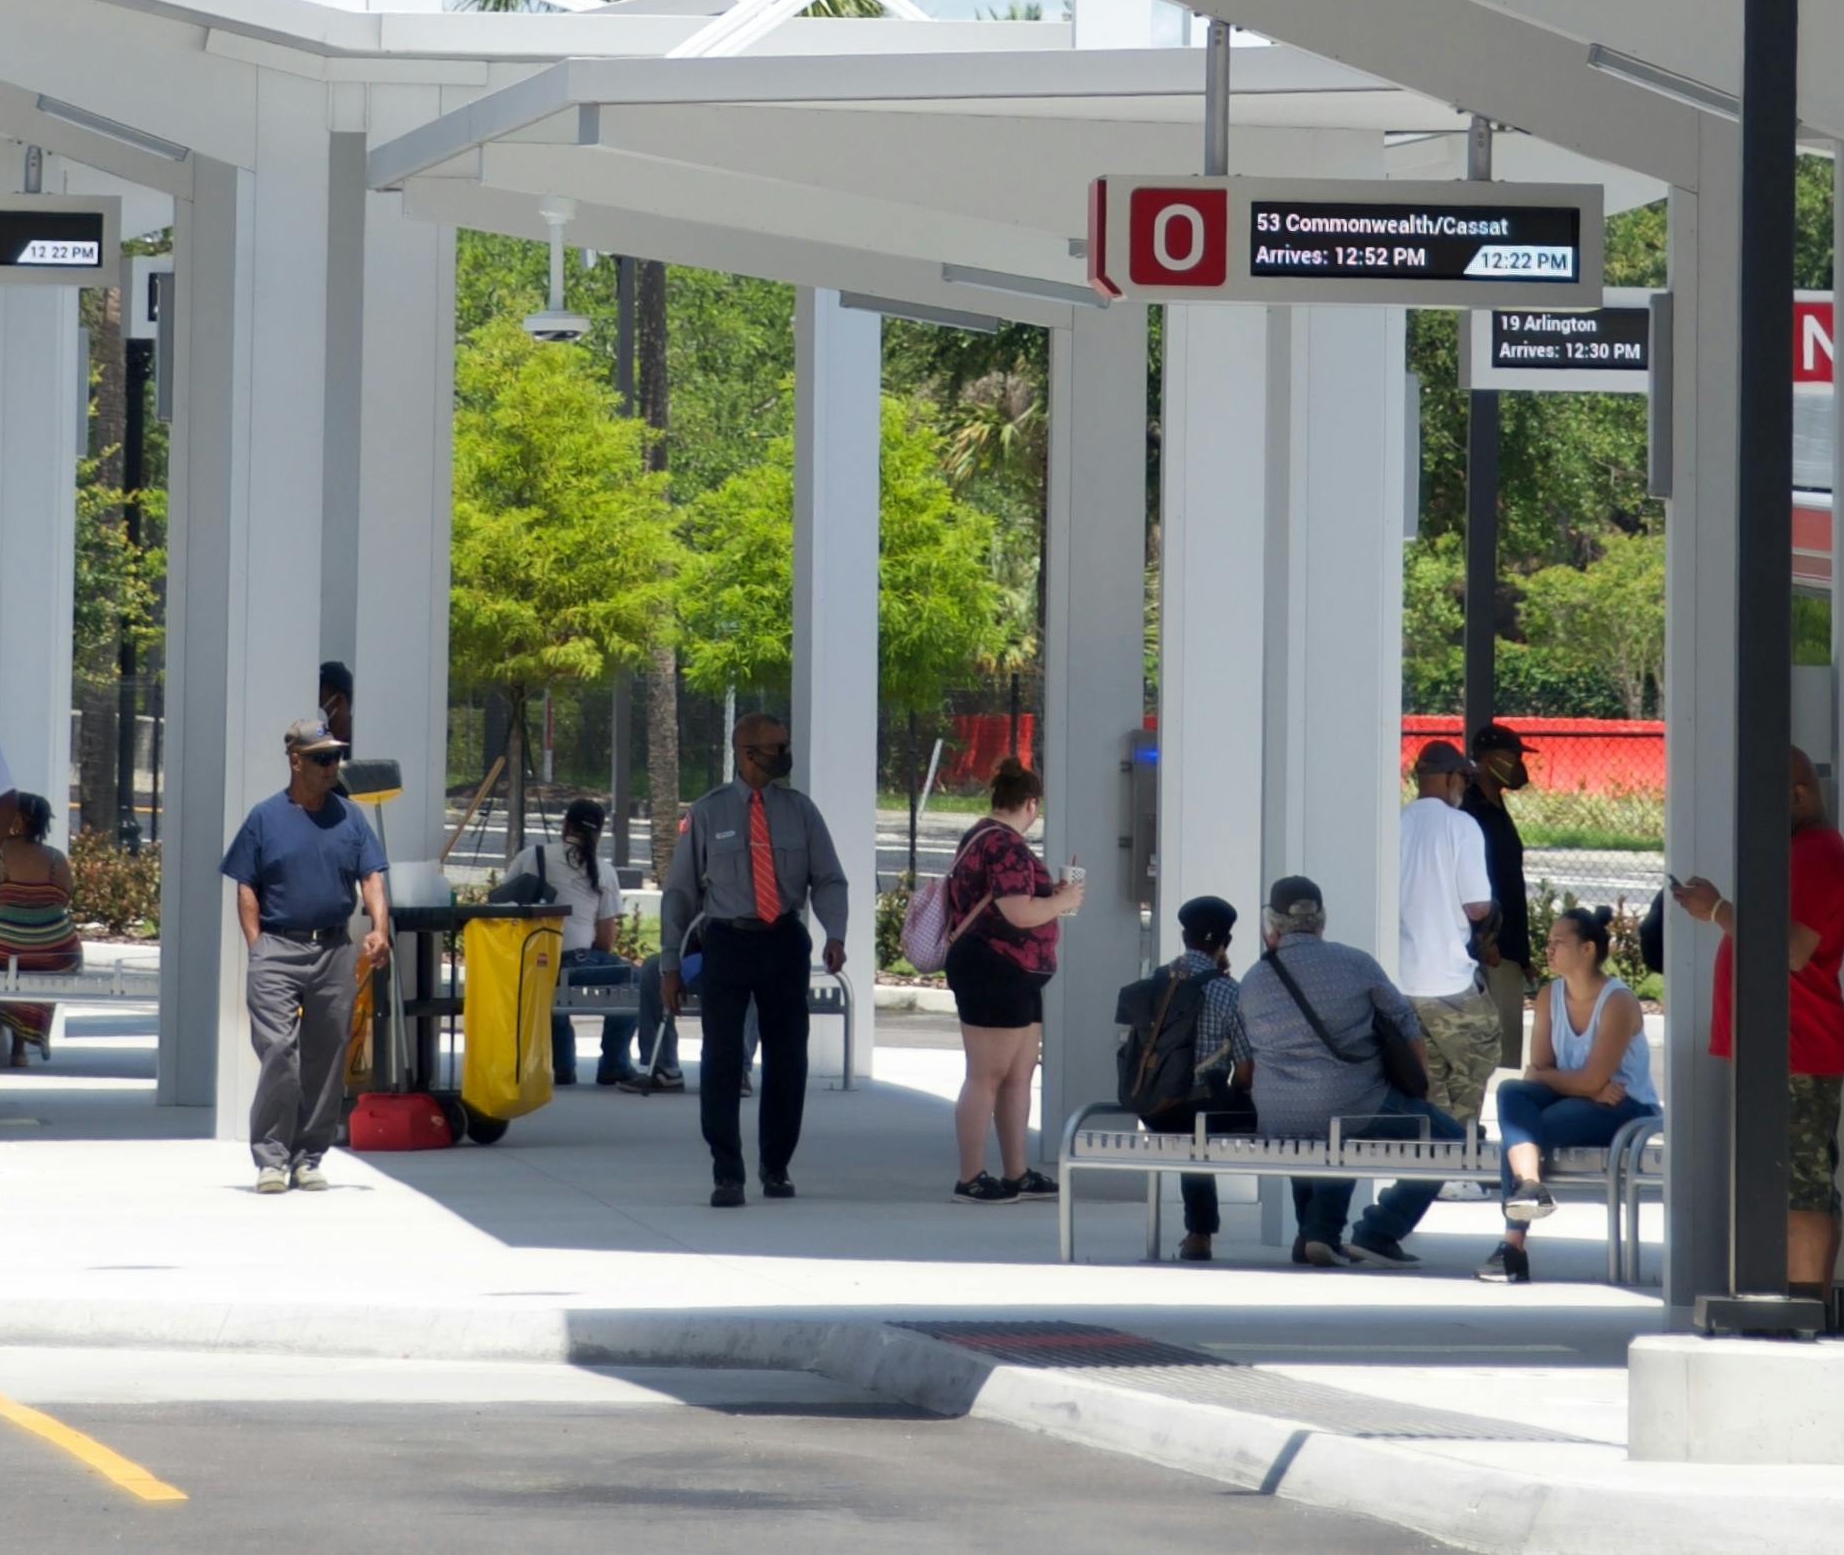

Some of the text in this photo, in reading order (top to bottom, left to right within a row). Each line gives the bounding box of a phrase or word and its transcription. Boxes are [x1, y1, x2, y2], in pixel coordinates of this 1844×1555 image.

[1256, 212, 1509, 236] 53 Commonwealth/Cassat
[1153, 203, 1204, 271] O
[72, 246, 94, 259] PM
[1255, 243, 1426, 267] Arrives: 12:52 PM
[1481, 252, 1568, 270] 12:22 PM
[1500, 313, 1598, 335] 19 Arlington
[1499, 340, 1642, 360] Arrives: 12:30 PM
